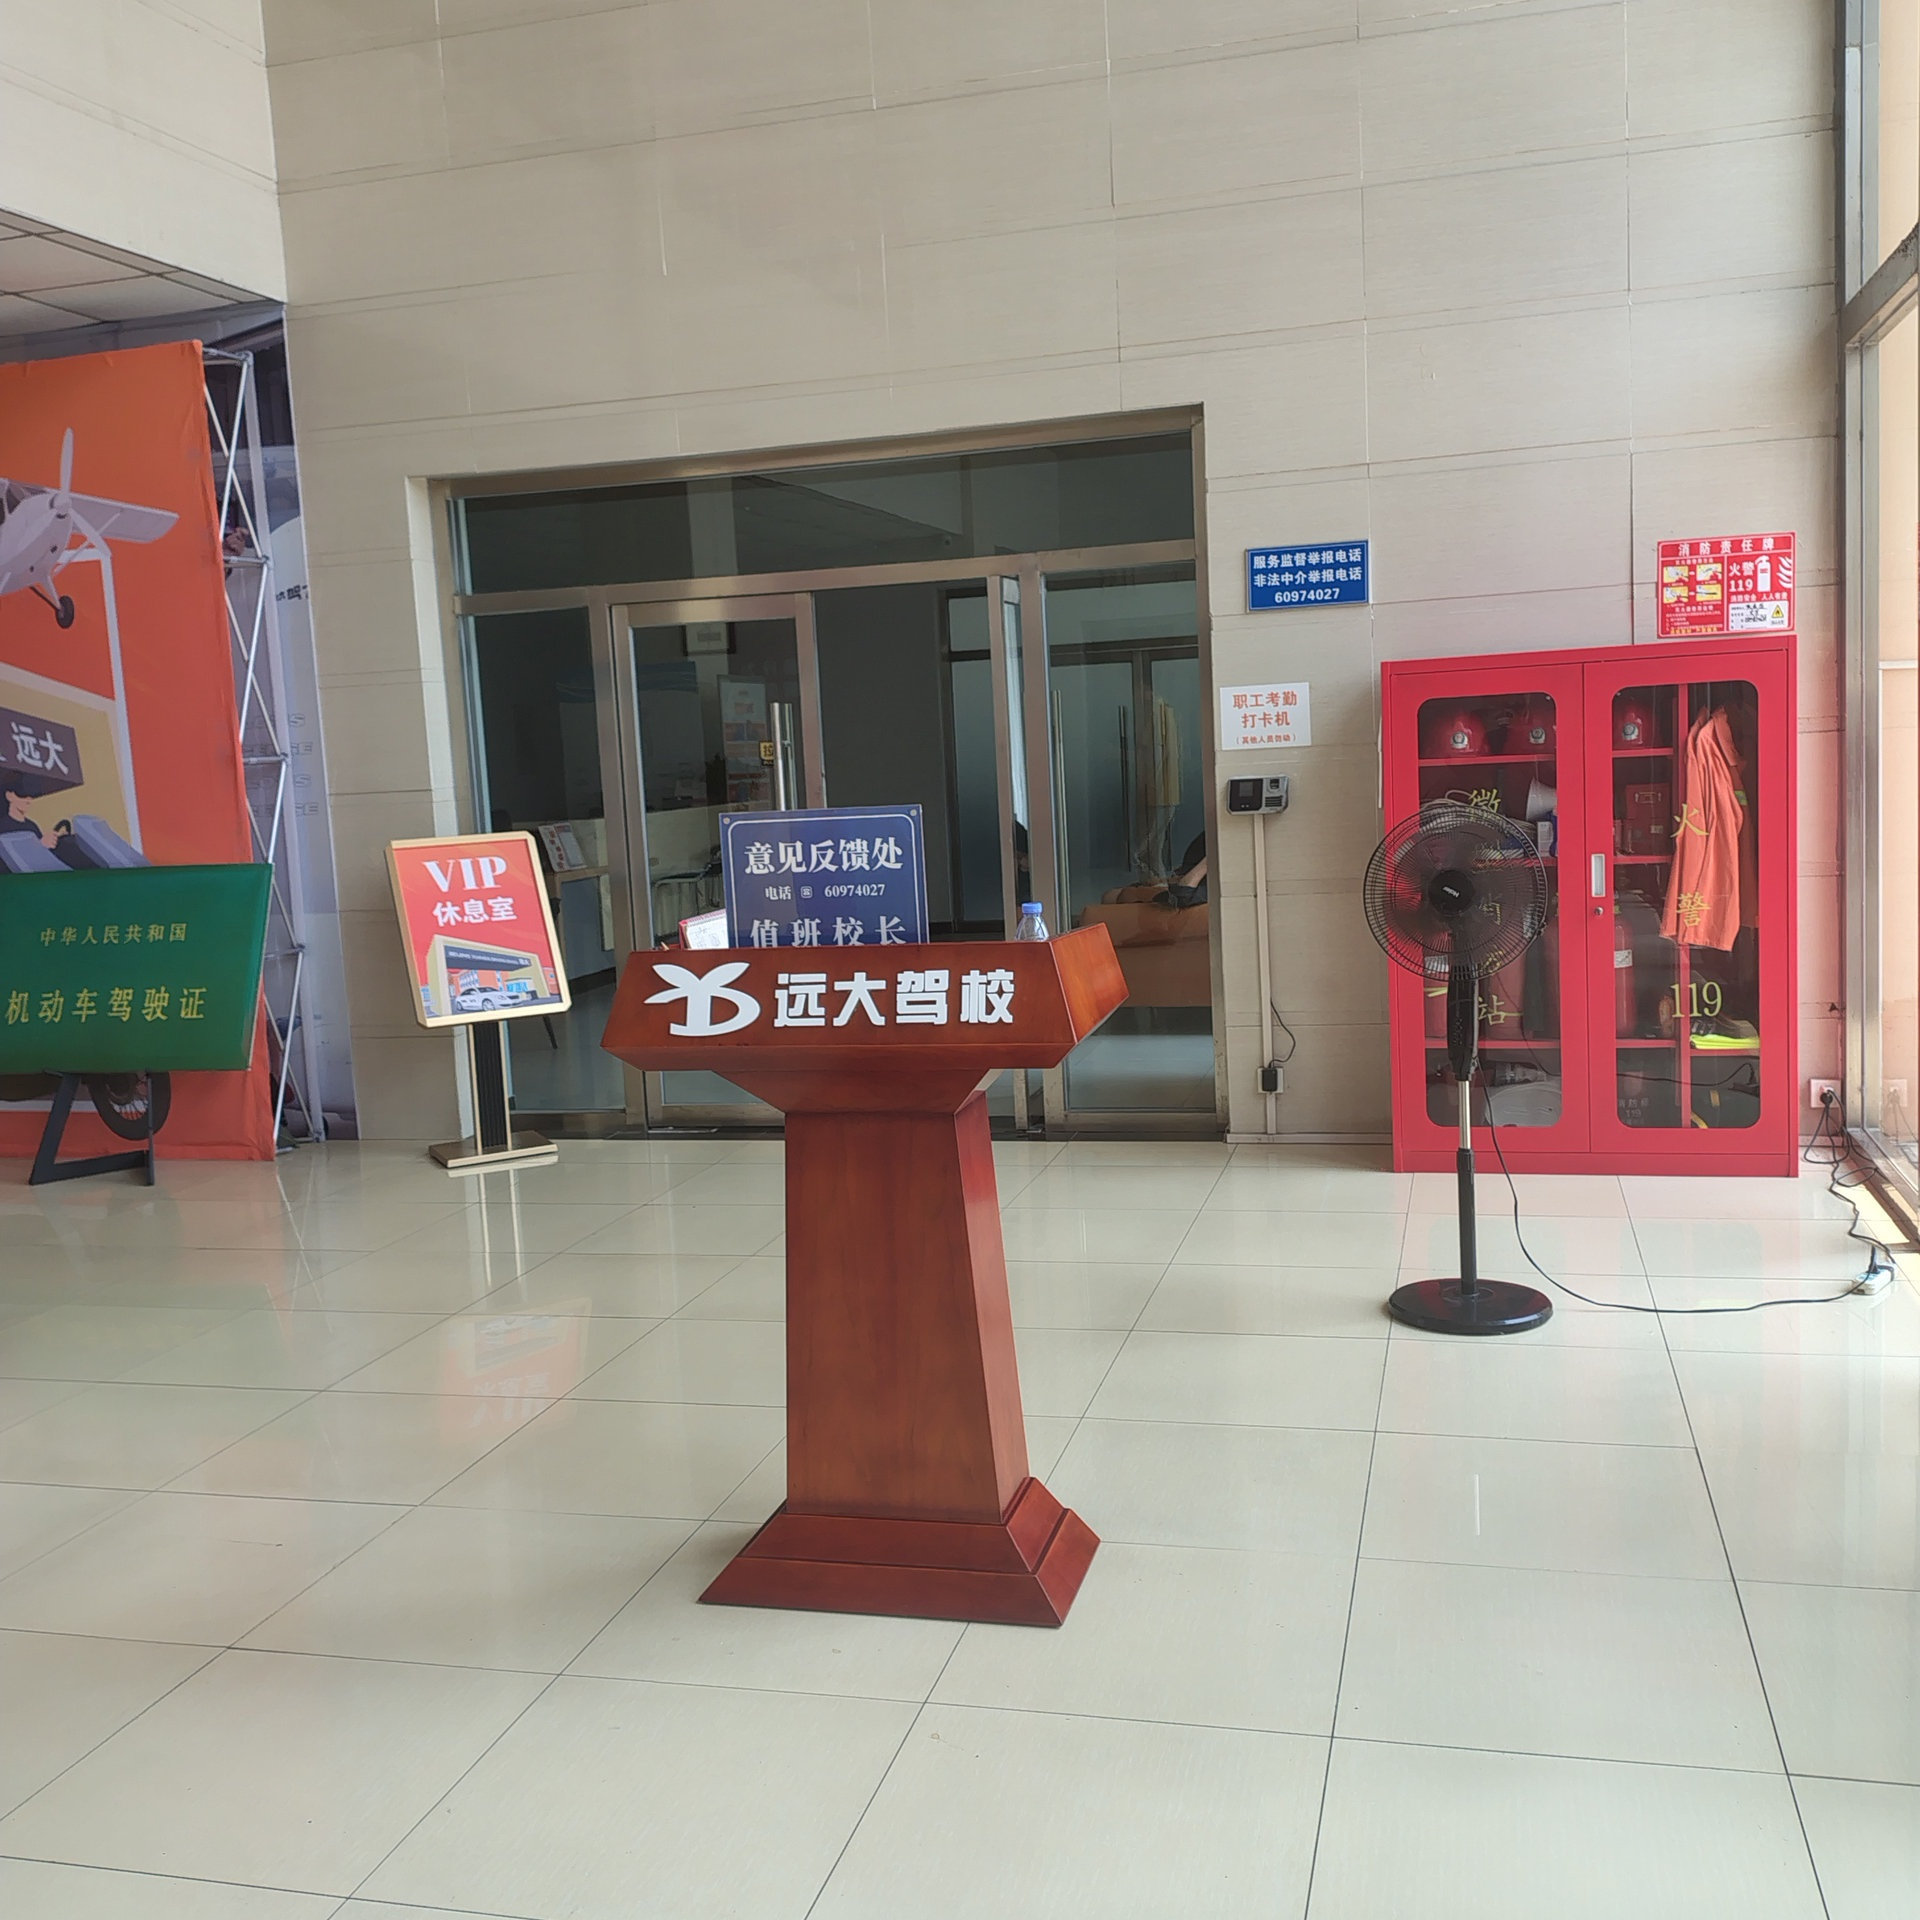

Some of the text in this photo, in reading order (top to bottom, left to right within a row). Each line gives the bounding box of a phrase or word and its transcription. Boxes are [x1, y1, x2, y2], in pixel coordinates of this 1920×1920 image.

[1253, 548, 1362, 569] 服务监督举报电话
[1729, 561, 1755, 577] 火警
[1253, 567, 1363, 588] 非法中介举报电话
[1729, 578, 1753, 592] 119
[1275, 588, 1340, 603] 60974027
[1232, 691, 1297, 709] 职工考勤
[1241, 711, 1290, 728] 打卡机
[11, 721, 69, 775] 远大
[744, 837, 903, 875] 意见反馈处
[422, 856, 507, 892] VIP
[764, 883, 886, 901] 电话 60974027
[432, 896, 518, 927] 休息室
[40, 922, 189, 947] 中华人民共和国
[750, 915, 907, 949] 值班校长
[5, 985, 208, 1025] 机动车驾驶证
[774, 968, 1015, 1028] 远大驾校
[1671, 981, 1722, 1018] 119
